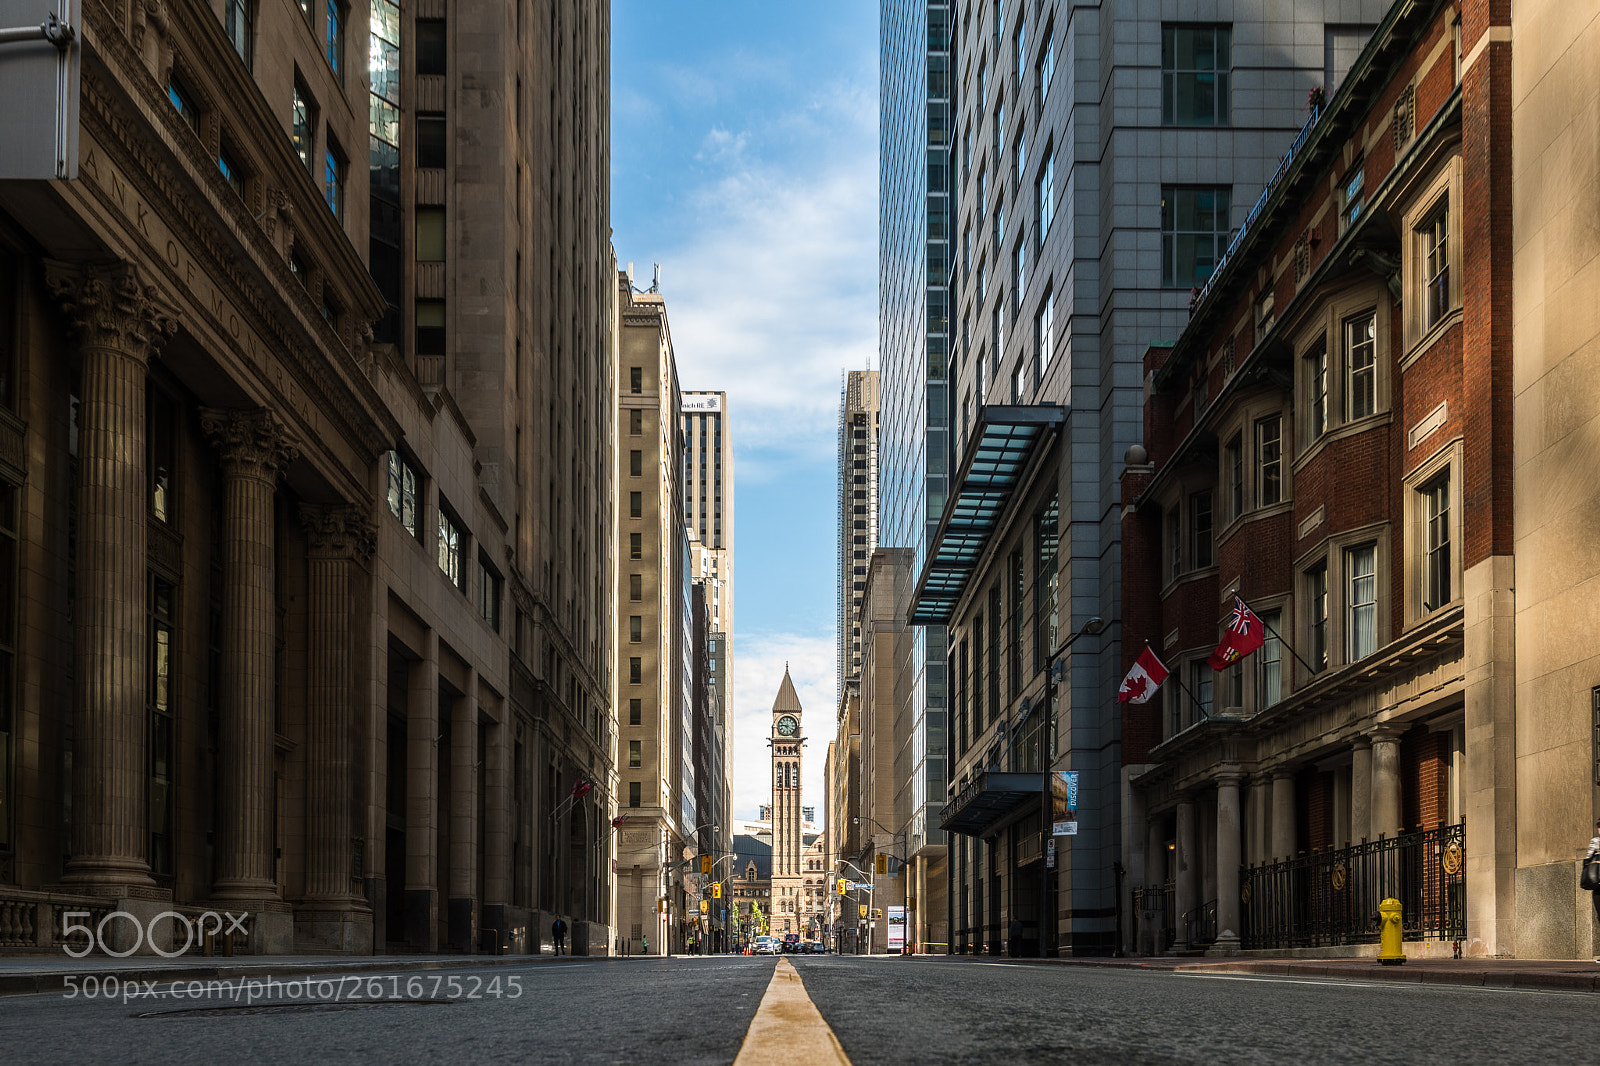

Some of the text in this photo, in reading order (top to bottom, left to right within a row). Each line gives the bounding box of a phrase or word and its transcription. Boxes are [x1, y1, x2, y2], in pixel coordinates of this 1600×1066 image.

[85, 148, 322, 436] ANK OF MONTREAL
[1070, 773, 1079, 806] DISCOVER
